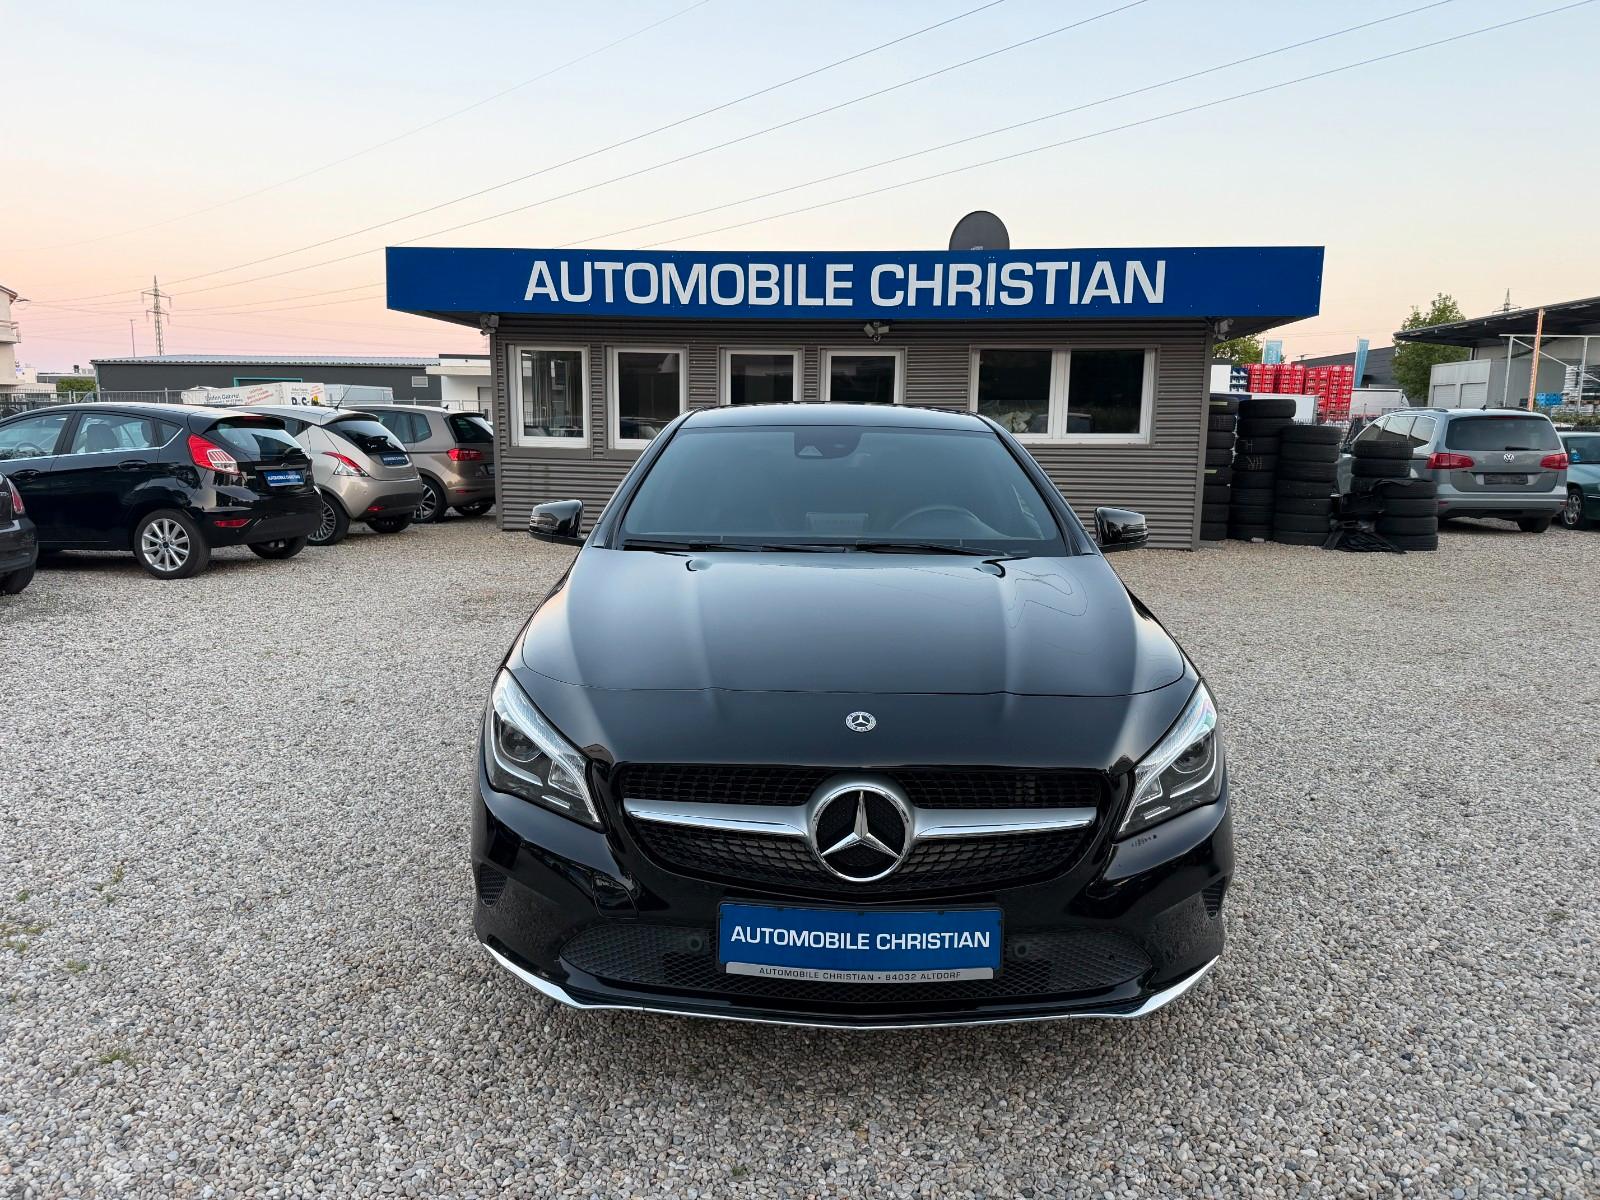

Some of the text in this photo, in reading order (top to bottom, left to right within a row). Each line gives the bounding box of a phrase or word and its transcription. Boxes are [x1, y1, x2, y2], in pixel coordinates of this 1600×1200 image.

[524, 260, 1166, 307] AUTOMOBILE CHRISTIAN
[731, 925, 990, 950] AUTOMOBILE CHRISTIAN
[759, 967, 961, 981] AUTOMOBILE CHRISTIAN 84032 ALTDORF
